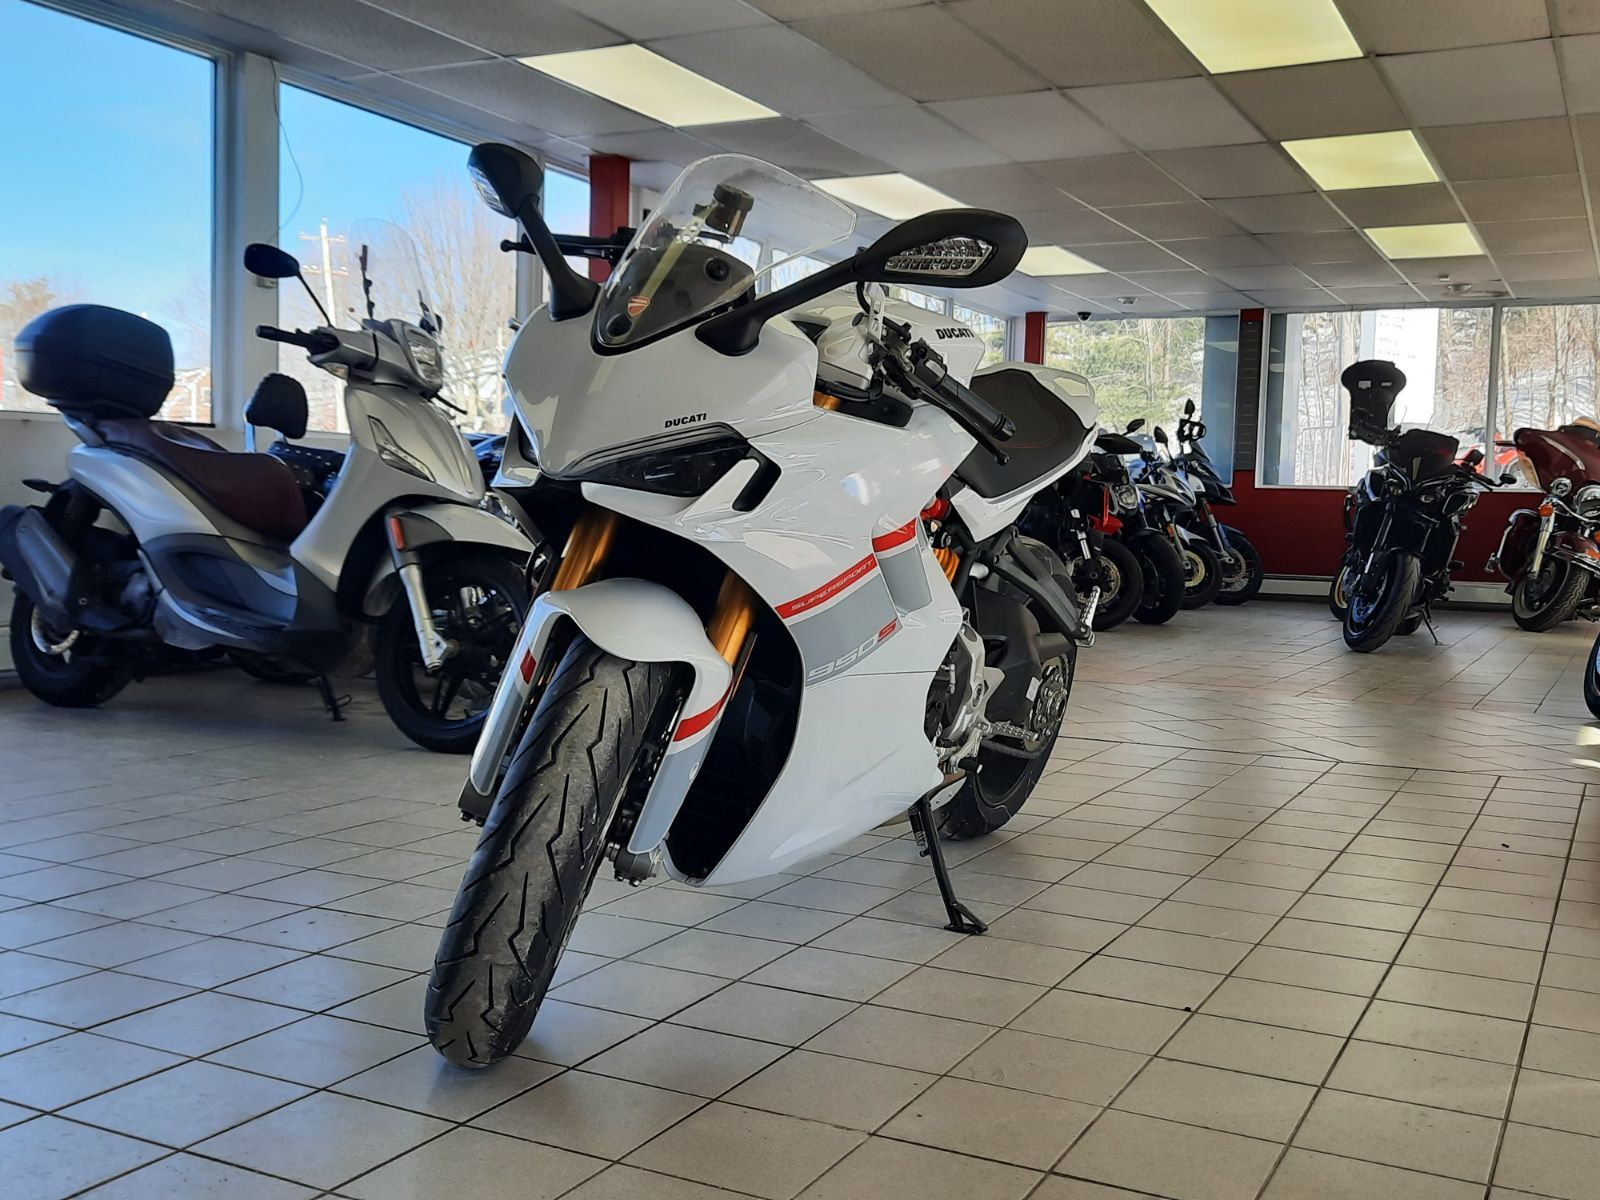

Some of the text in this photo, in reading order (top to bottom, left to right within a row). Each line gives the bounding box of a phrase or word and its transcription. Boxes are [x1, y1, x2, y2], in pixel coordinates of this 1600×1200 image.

[935, 328, 975, 340] DUCATI
[664, 412, 707, 429] DUCATI
[791, 558, 874, 611] SUPERSPORT
